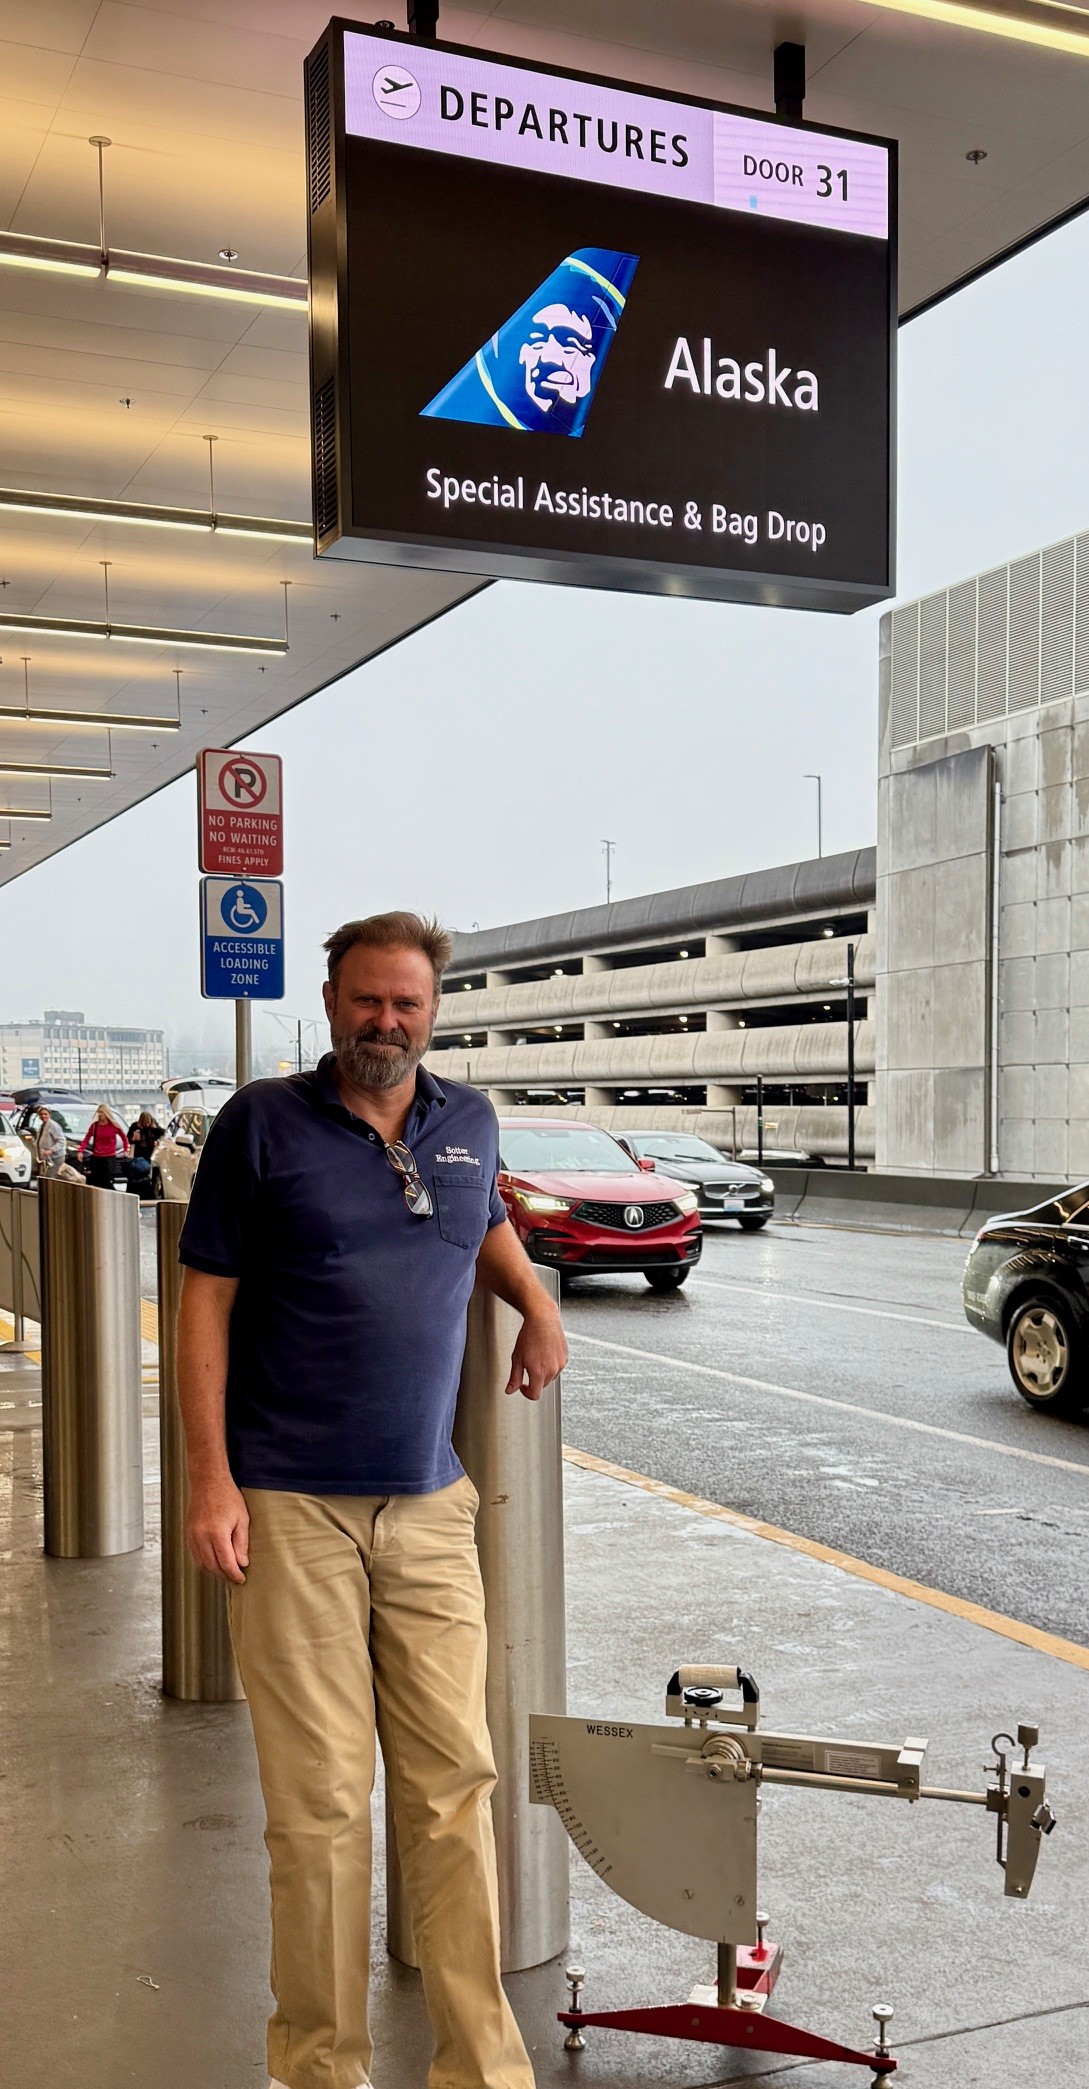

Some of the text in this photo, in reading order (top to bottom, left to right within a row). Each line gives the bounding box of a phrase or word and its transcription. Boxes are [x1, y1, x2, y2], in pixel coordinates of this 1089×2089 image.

[440, 85, 689, 168] DEPARTURES
[743, 155, 848, 202] DOOR 31
[664, 336, 819, 411] Alaska
[426, 468, 826, 552] Special Assistance & Bag Drop
[208, 814, 278, 831] NO PARKING
[209, 831, 277, 846] NO WAITING
[218, 855, 269, 867] FINES APPLY
[213, 941, 276, 955] ACCESSIBLE
[220, 957, 269, 970] LOADING
[230, 973, 259, 985] ZONE
[435, 1154, 481, 1166] Engineering
[586, 1724, 634, 1739] WESSEX
